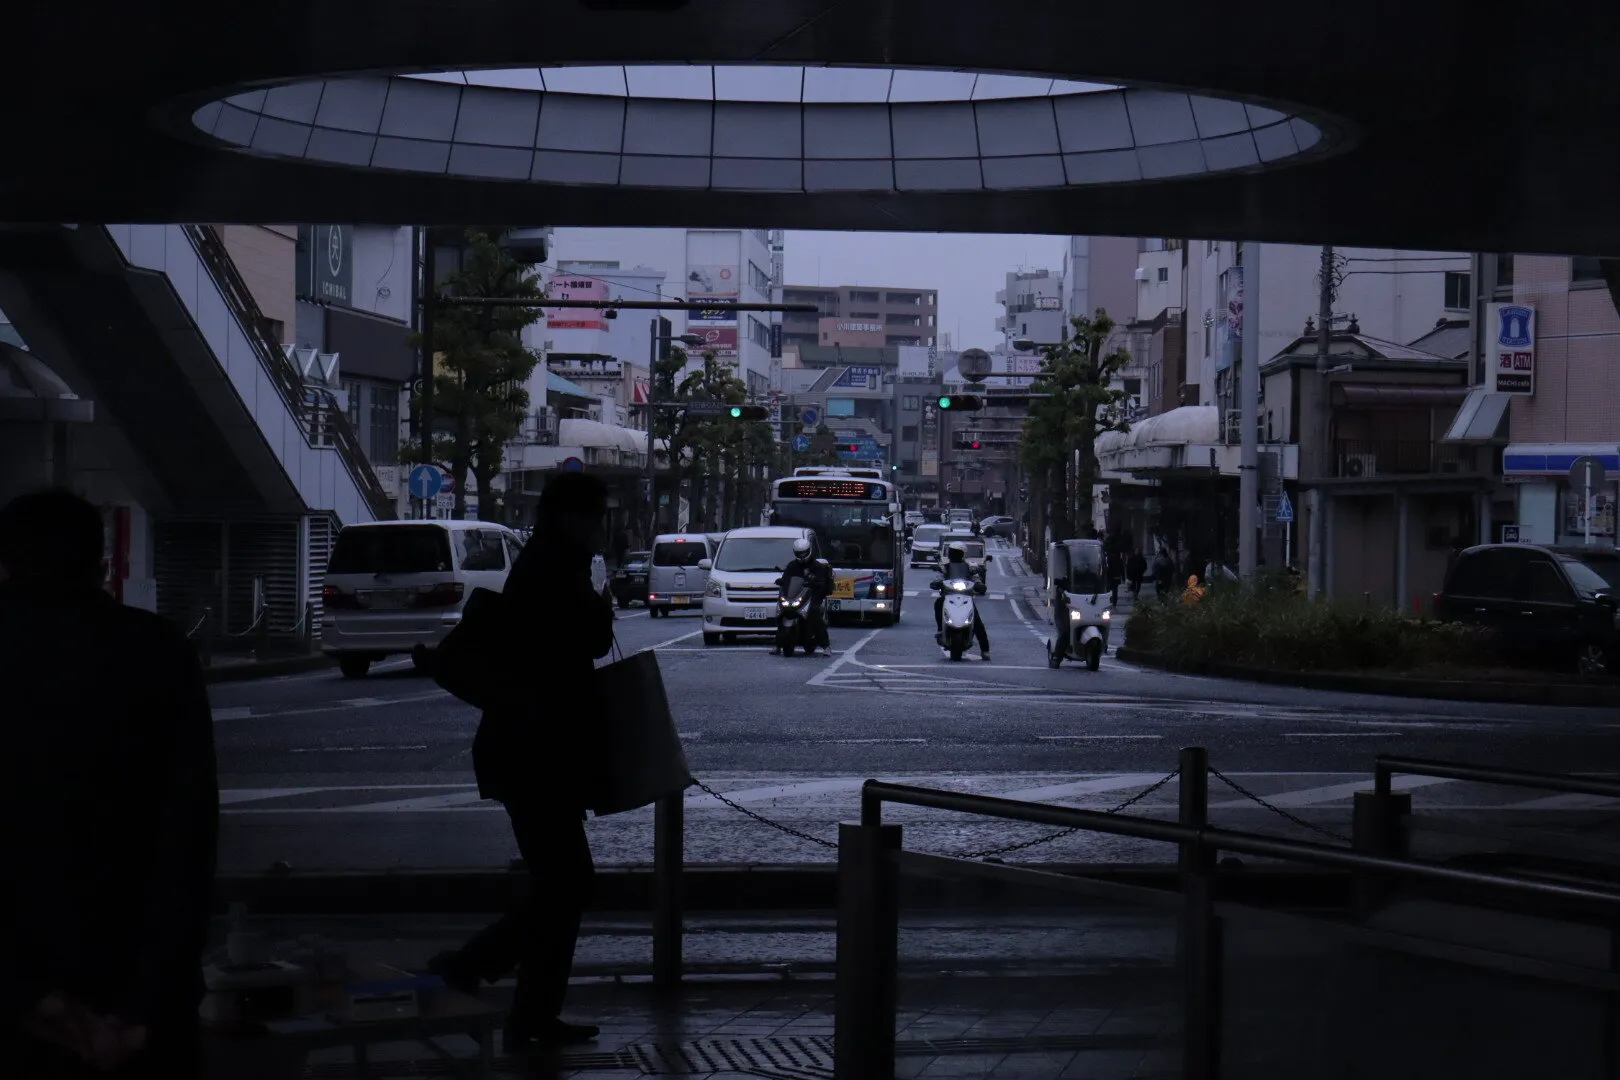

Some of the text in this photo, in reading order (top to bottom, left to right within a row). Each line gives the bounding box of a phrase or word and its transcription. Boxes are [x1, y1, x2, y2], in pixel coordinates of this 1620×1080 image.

[1500, 354, 1512, 368] 酒
[1515, 355, 1531, 369] ATM
[1499, 379, 1518, 387] MACHI
